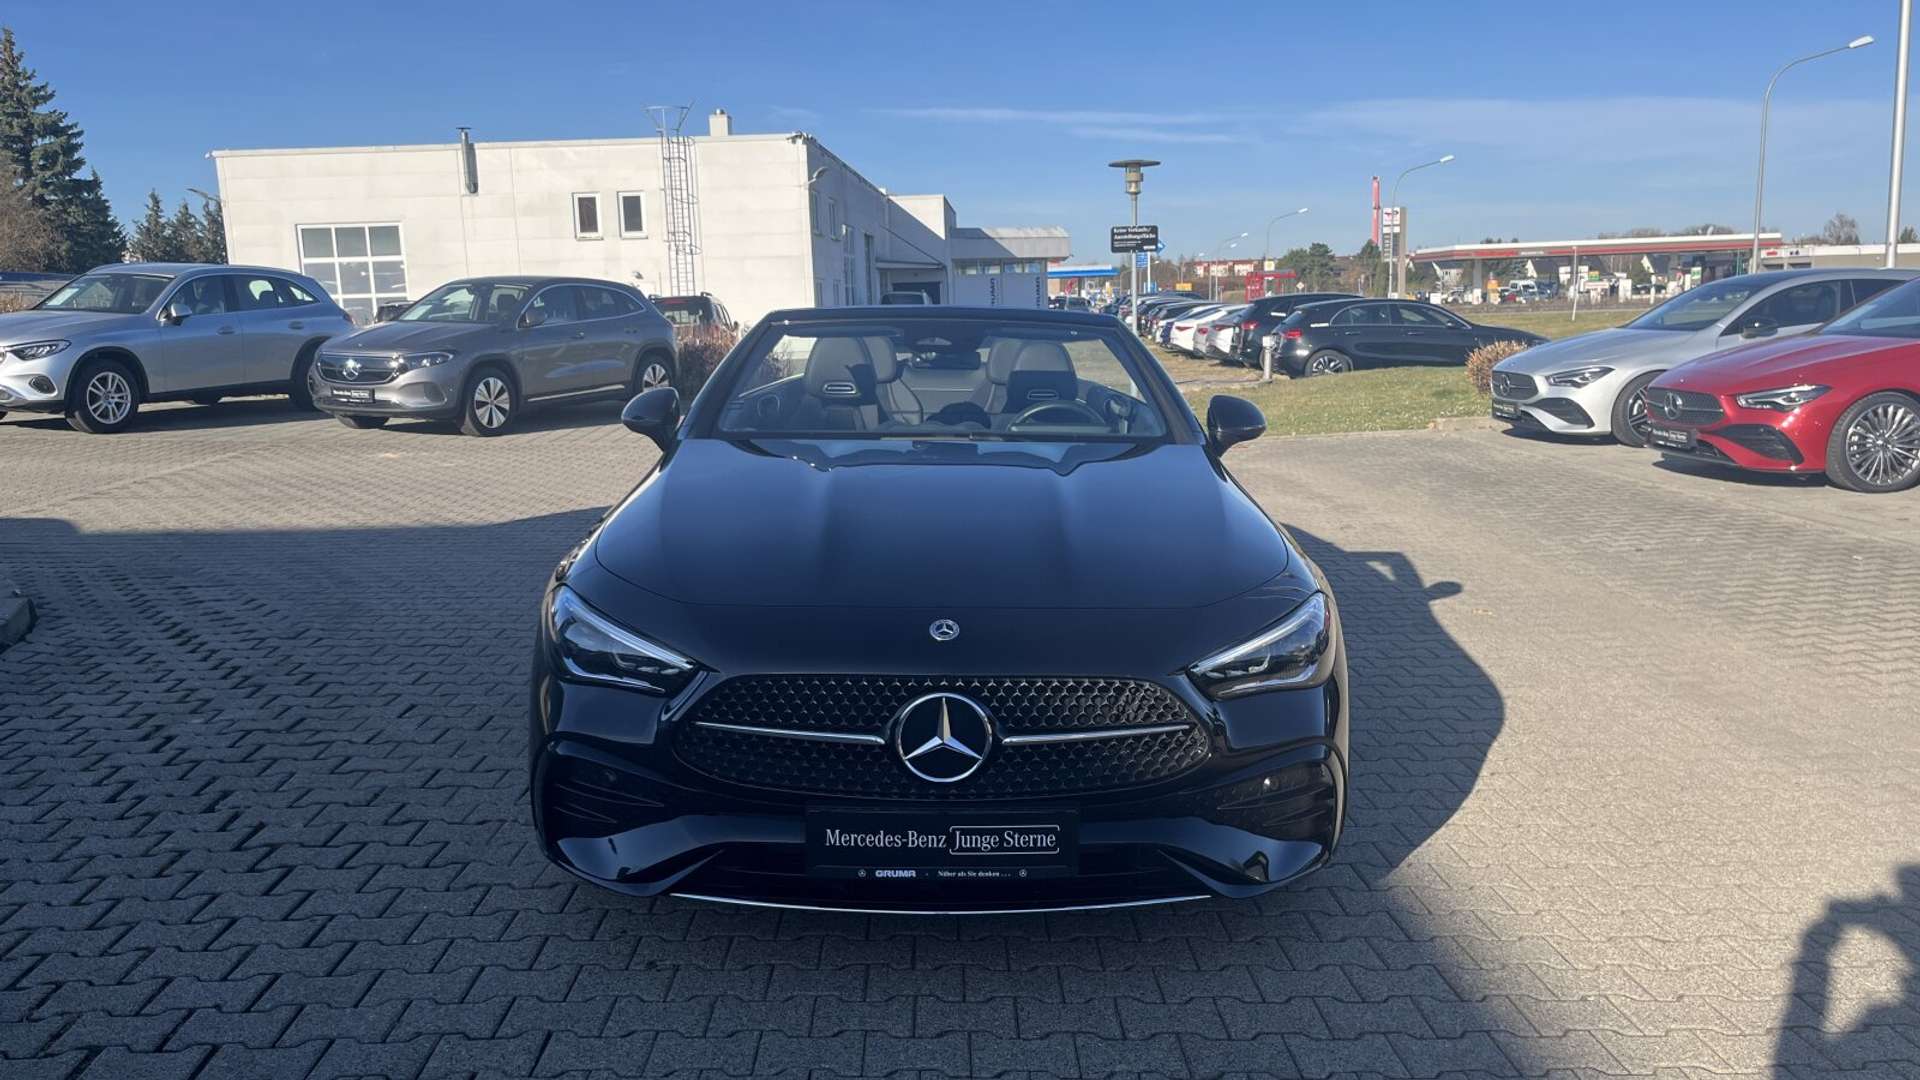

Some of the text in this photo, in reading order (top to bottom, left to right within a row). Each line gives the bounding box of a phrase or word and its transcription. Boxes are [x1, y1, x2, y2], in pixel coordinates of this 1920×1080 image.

[825, 829, 1056, 852] Mercedes-Benz Junge Sterne
[875, 869, 917, 878] GRUMA
